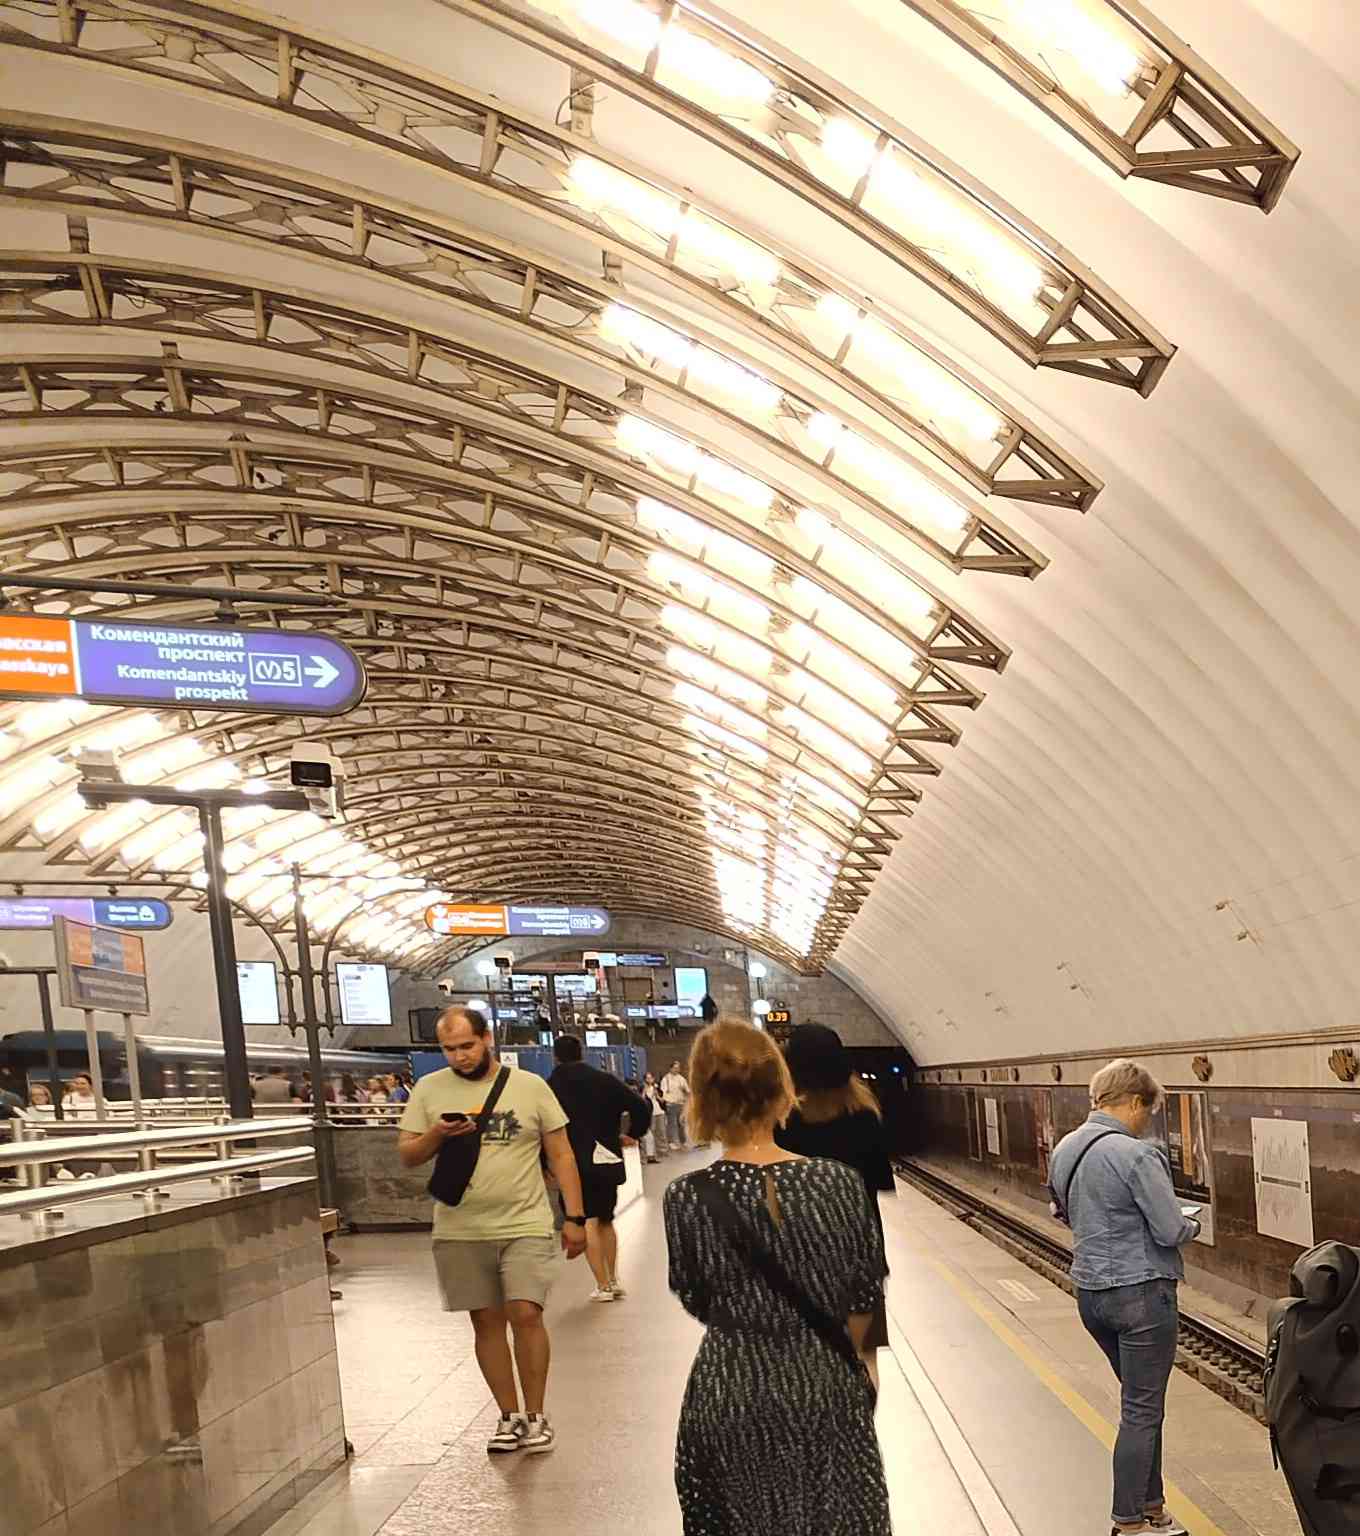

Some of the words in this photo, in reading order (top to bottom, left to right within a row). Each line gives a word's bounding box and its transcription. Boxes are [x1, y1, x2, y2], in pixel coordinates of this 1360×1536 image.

[90, 625, 244, 648] Комендантский
[158, 646, 245, 663] проспект
[117, 664, 246, 687] Komendantskiy
[175, 684, 248, 701] prospekt
